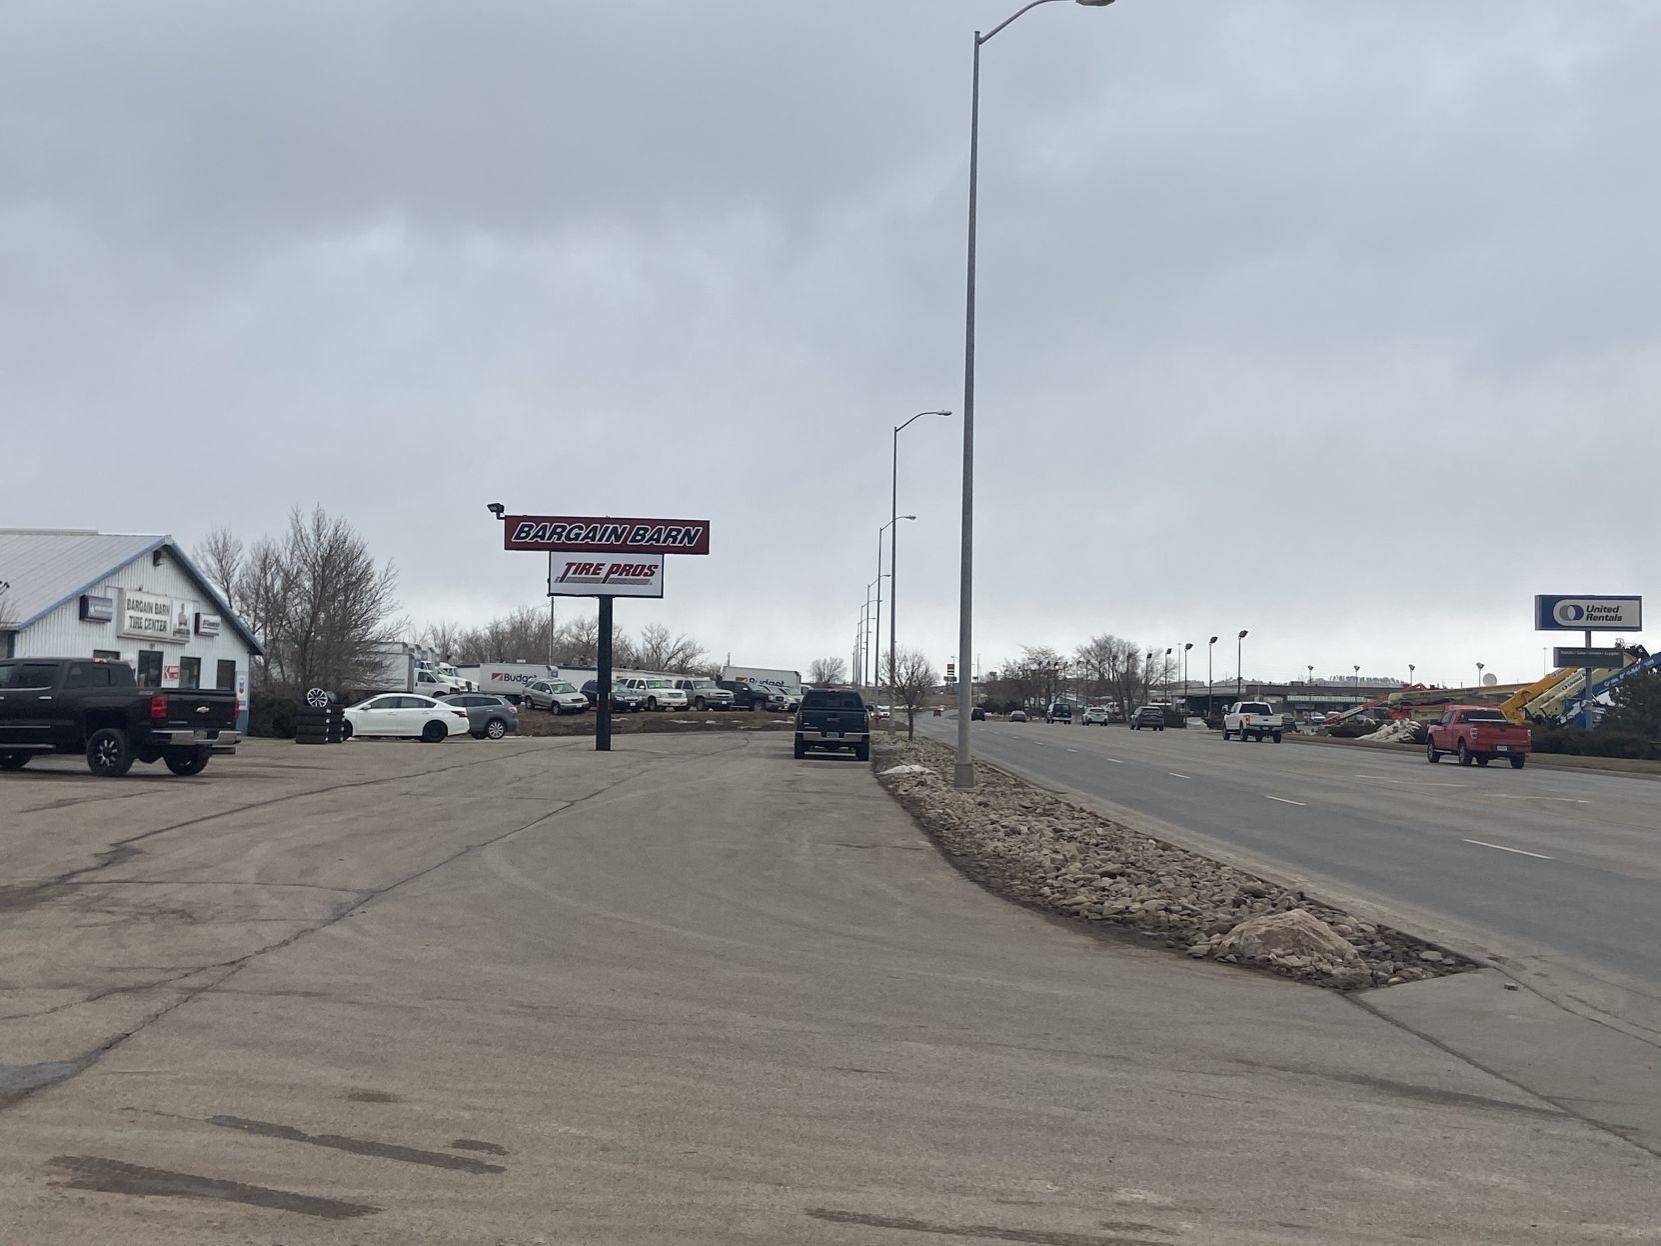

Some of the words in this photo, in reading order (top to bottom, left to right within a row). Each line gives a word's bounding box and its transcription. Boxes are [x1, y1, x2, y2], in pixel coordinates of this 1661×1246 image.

[512, 523, 628, 544] BARGAIN
[628, 525, 703, 546] BARN
[558, 562, 606, 584] TIRE
[601, 562, 659, 584] PROS
[127, 599, 153, 615] BARGAIN
[154, 602, 171, 616] BARN
[1586, 605, 1620, 613] United
[129, 616, 143, 630] TIRE
[144, 618, 168, 633] CENTER
[1586, 614, 1623, 622] Rentals
